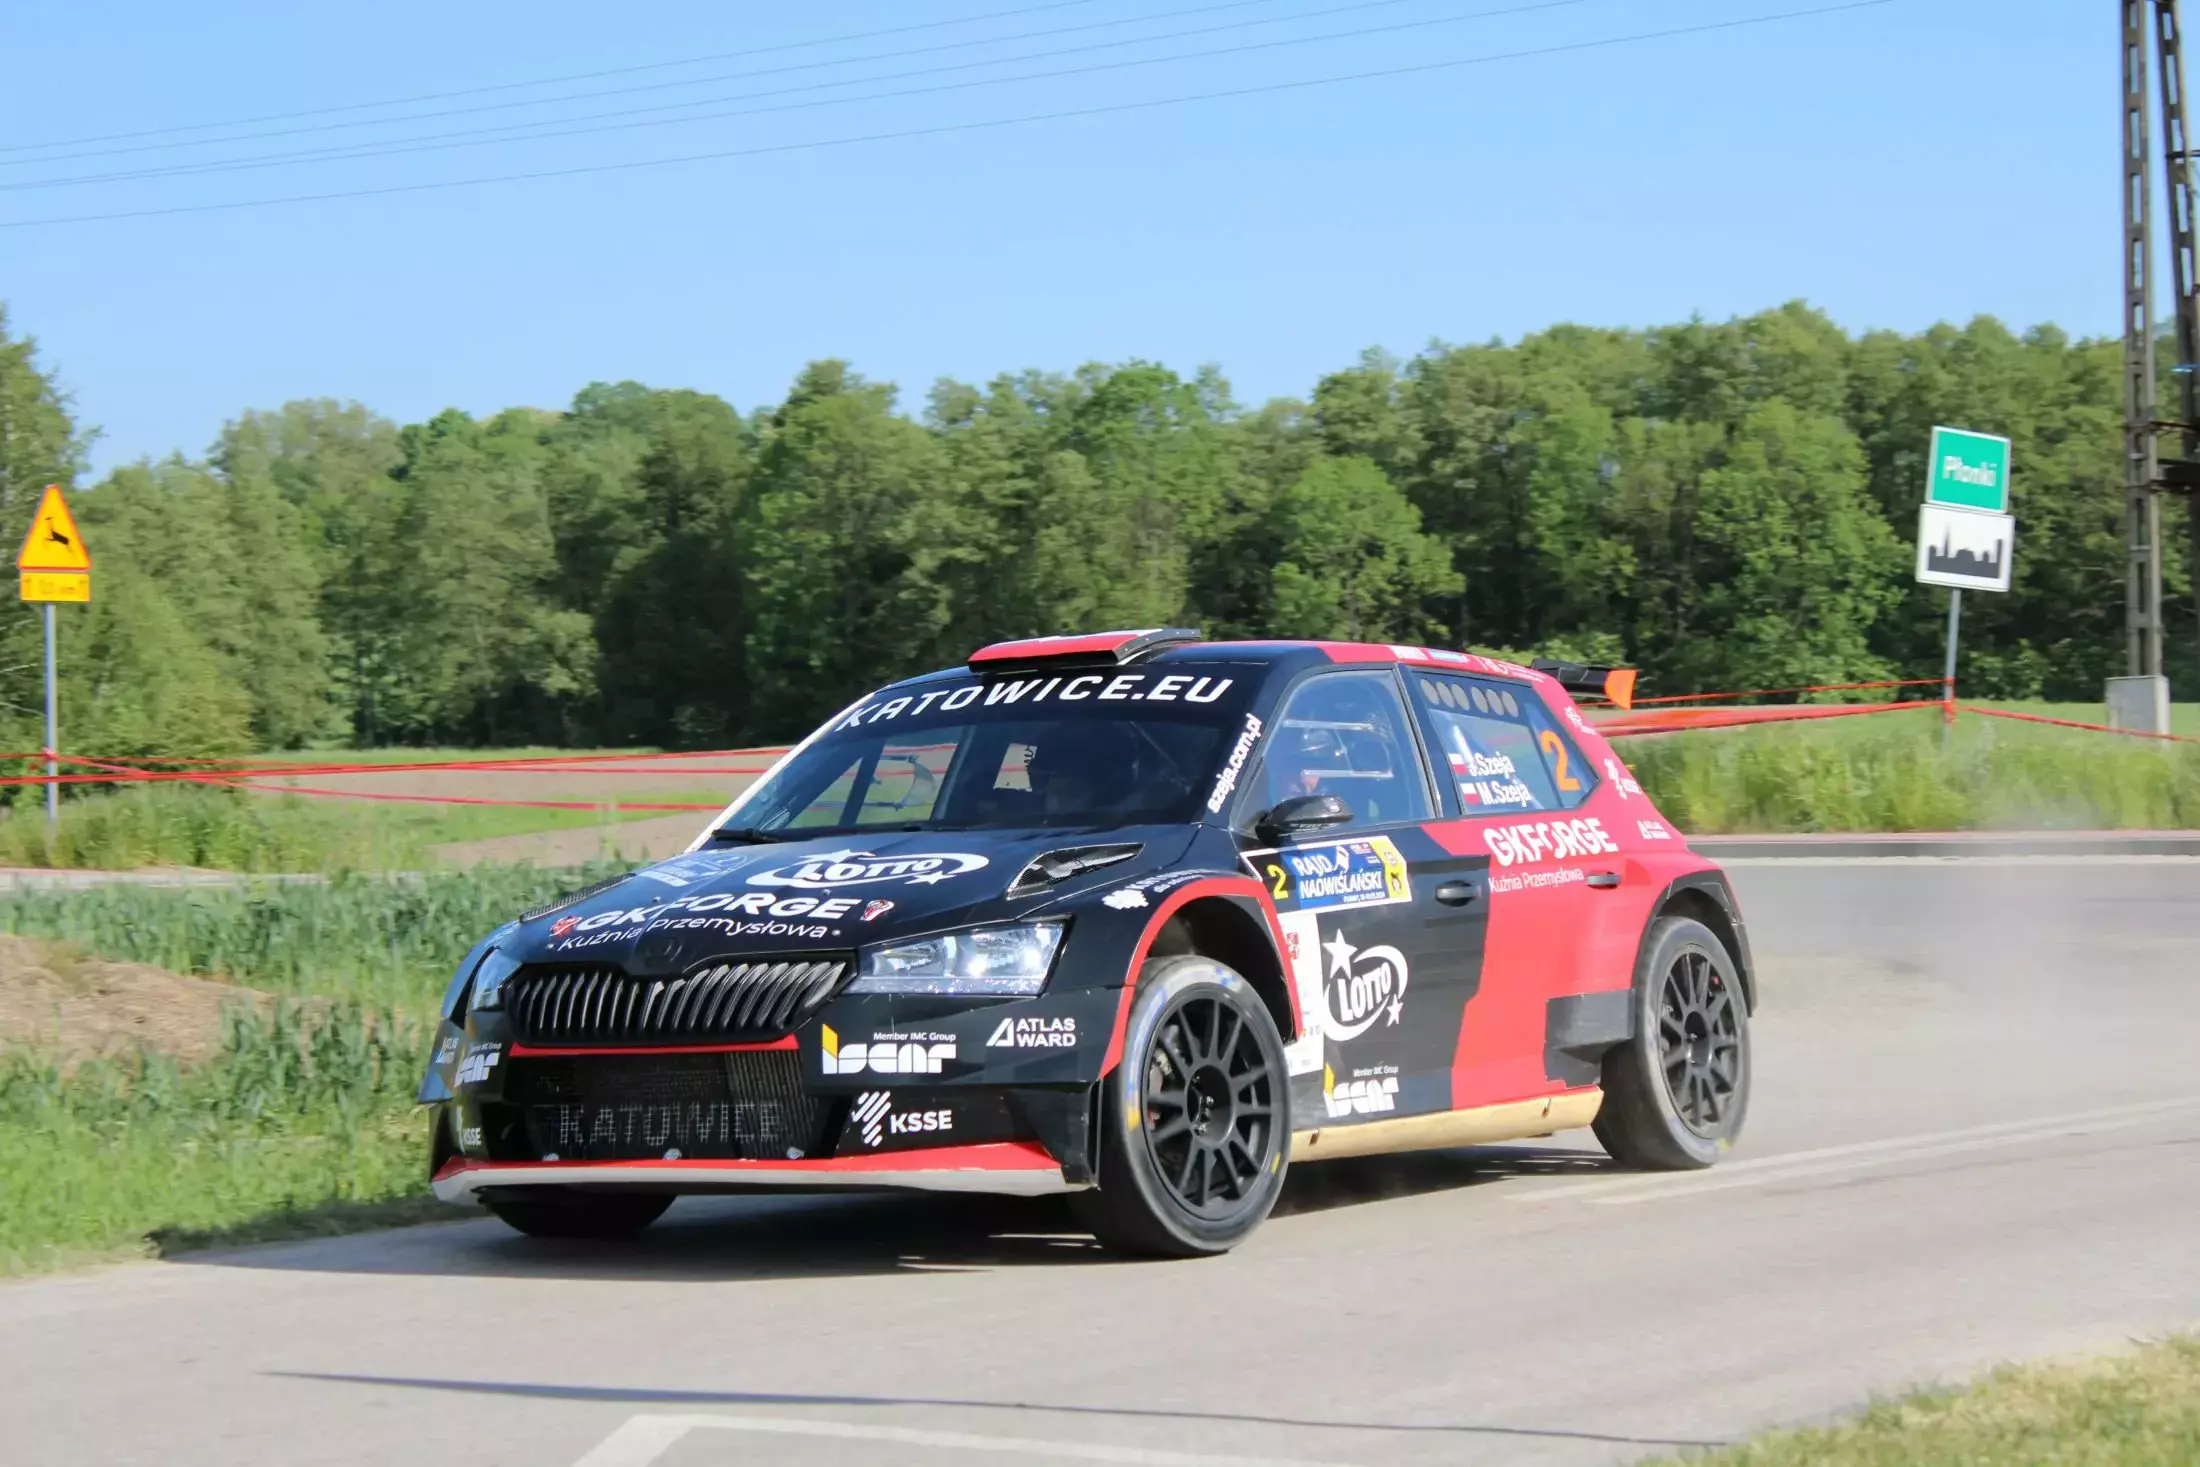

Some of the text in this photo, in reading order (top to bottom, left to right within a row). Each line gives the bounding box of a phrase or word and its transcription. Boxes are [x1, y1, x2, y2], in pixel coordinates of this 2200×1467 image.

[834, 675, 1234, 732] KATOWICE.EU
[1207, 712, 1262, 814] szeja.com.pl
[1539, 729, 1582, 792] 2
[792, 858, 943, 882] LOTTO
[1266, 863, 1289, 900] 2
[576, 892, 864, 932] GKFORGE
[1337, 962, 1392, 1022] LOTTO
[873, 1031, 957, 1044] Member IMC Group
[1015, 1032, 1076, 1048] WARD
[1016, 1017, 1076, 1033] ATLAS
[559, 1101, 786, 1147] KATOWICE
[889, 1109, 954, 1134] KSSE
